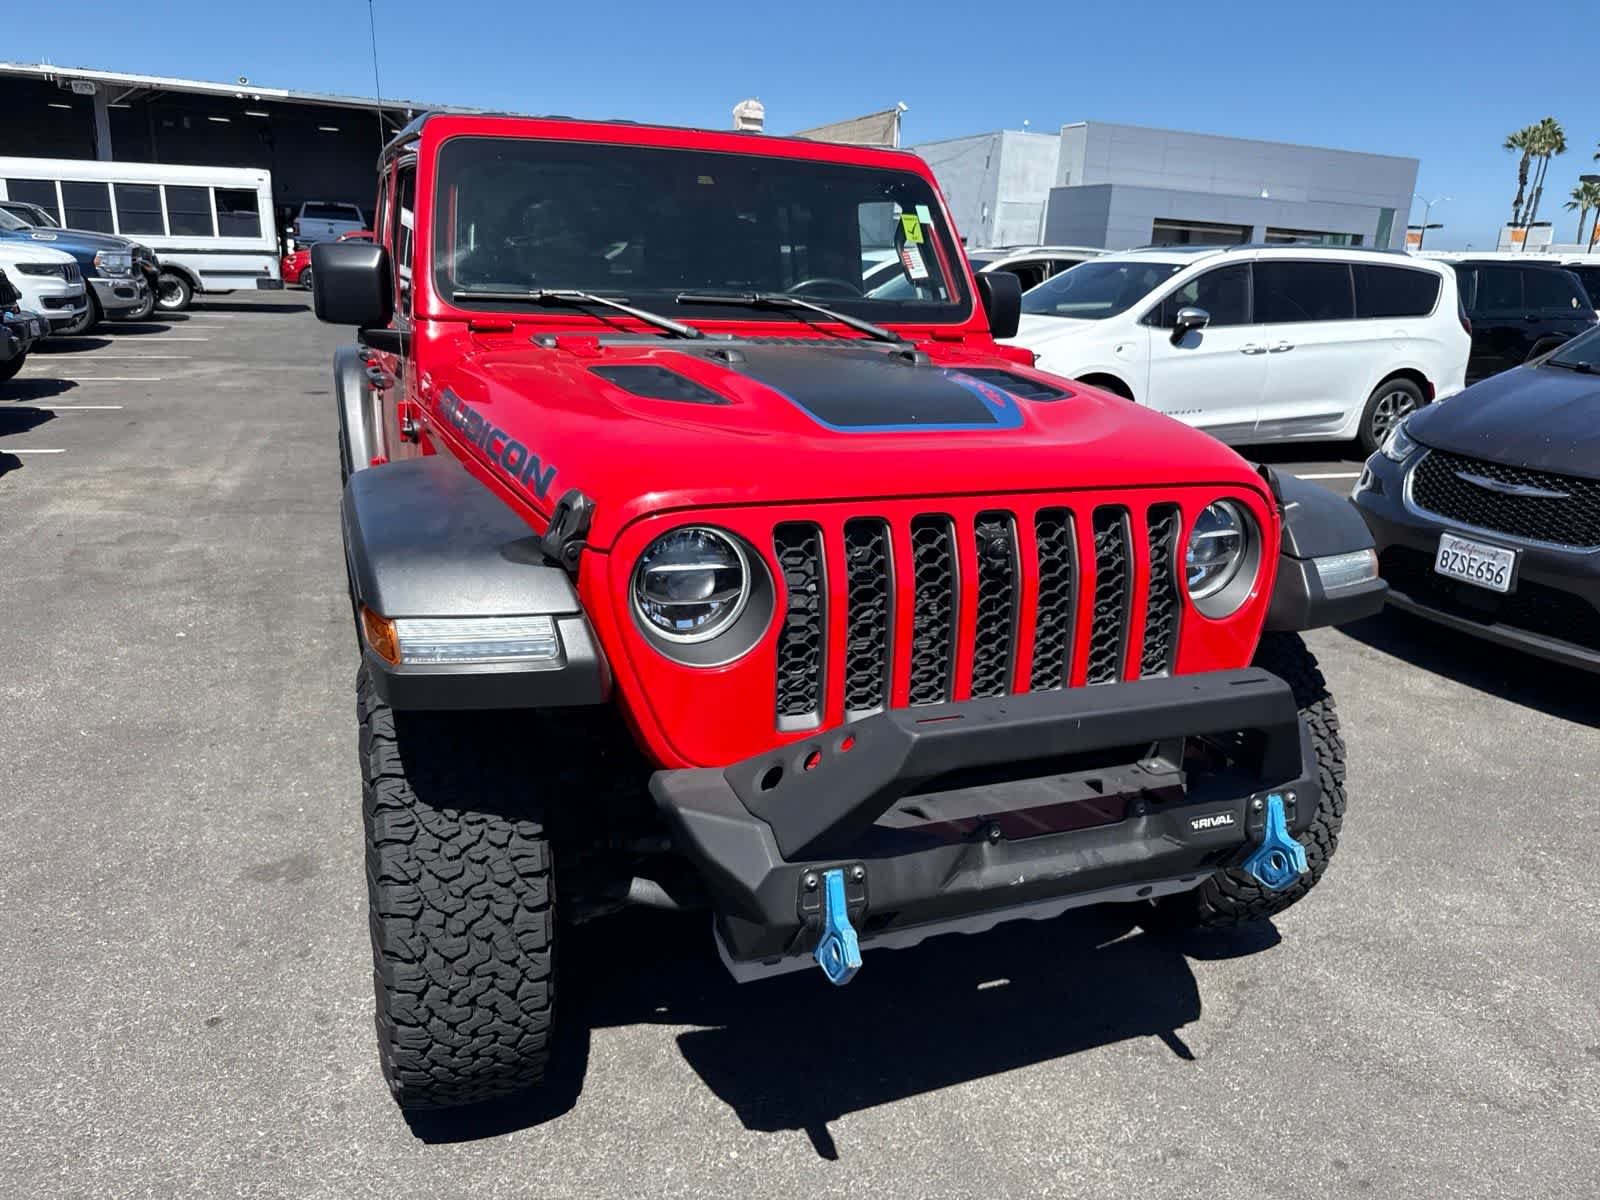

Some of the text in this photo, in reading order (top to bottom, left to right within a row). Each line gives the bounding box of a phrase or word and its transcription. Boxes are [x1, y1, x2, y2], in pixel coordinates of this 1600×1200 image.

[439, 387, 557, 499] RUBICON
[1440, 550, 1506, 585] 8ZSE656
[1199, 814, 1234, 829] RIVAL
